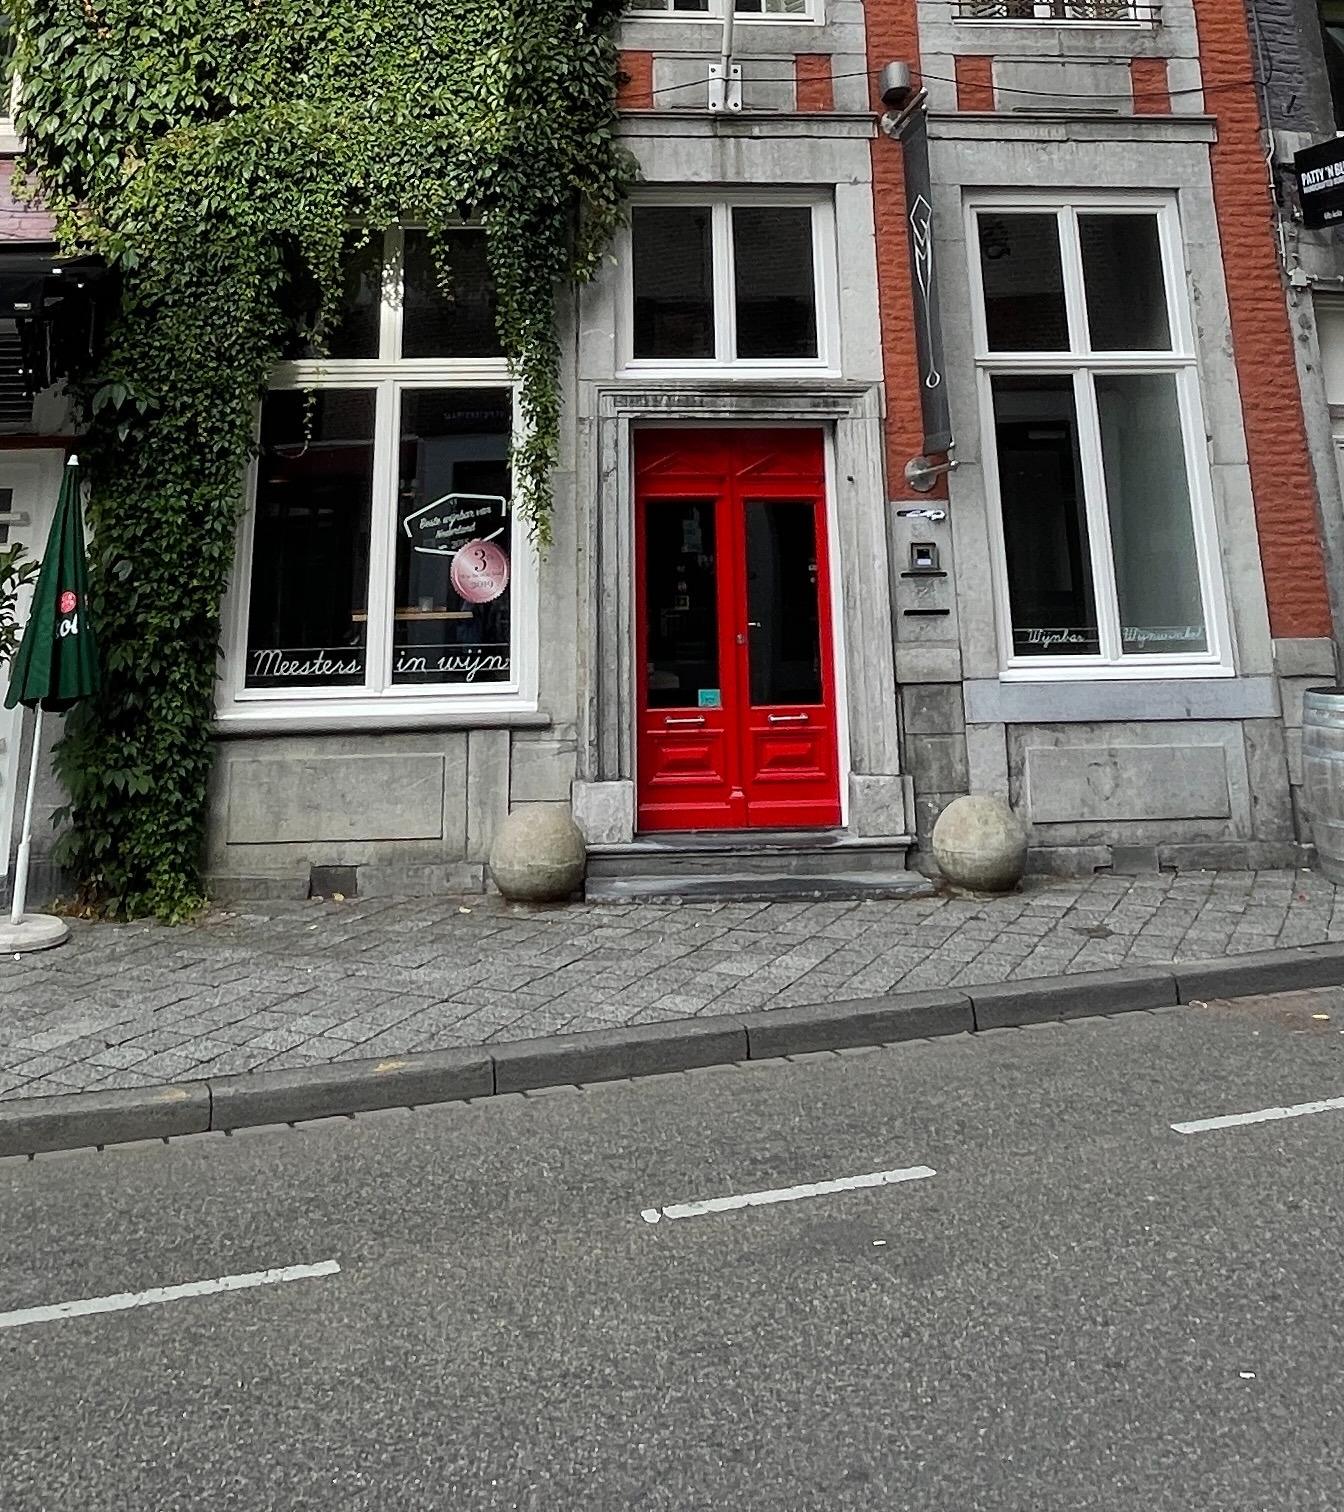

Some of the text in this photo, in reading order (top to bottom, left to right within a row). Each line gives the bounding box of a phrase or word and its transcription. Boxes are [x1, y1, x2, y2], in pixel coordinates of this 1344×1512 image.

[1301, 167, 1325, 187] PATTY
[474, 548, 487, 573] 3
[254, 648, 510, 683] Meesters in wijn
